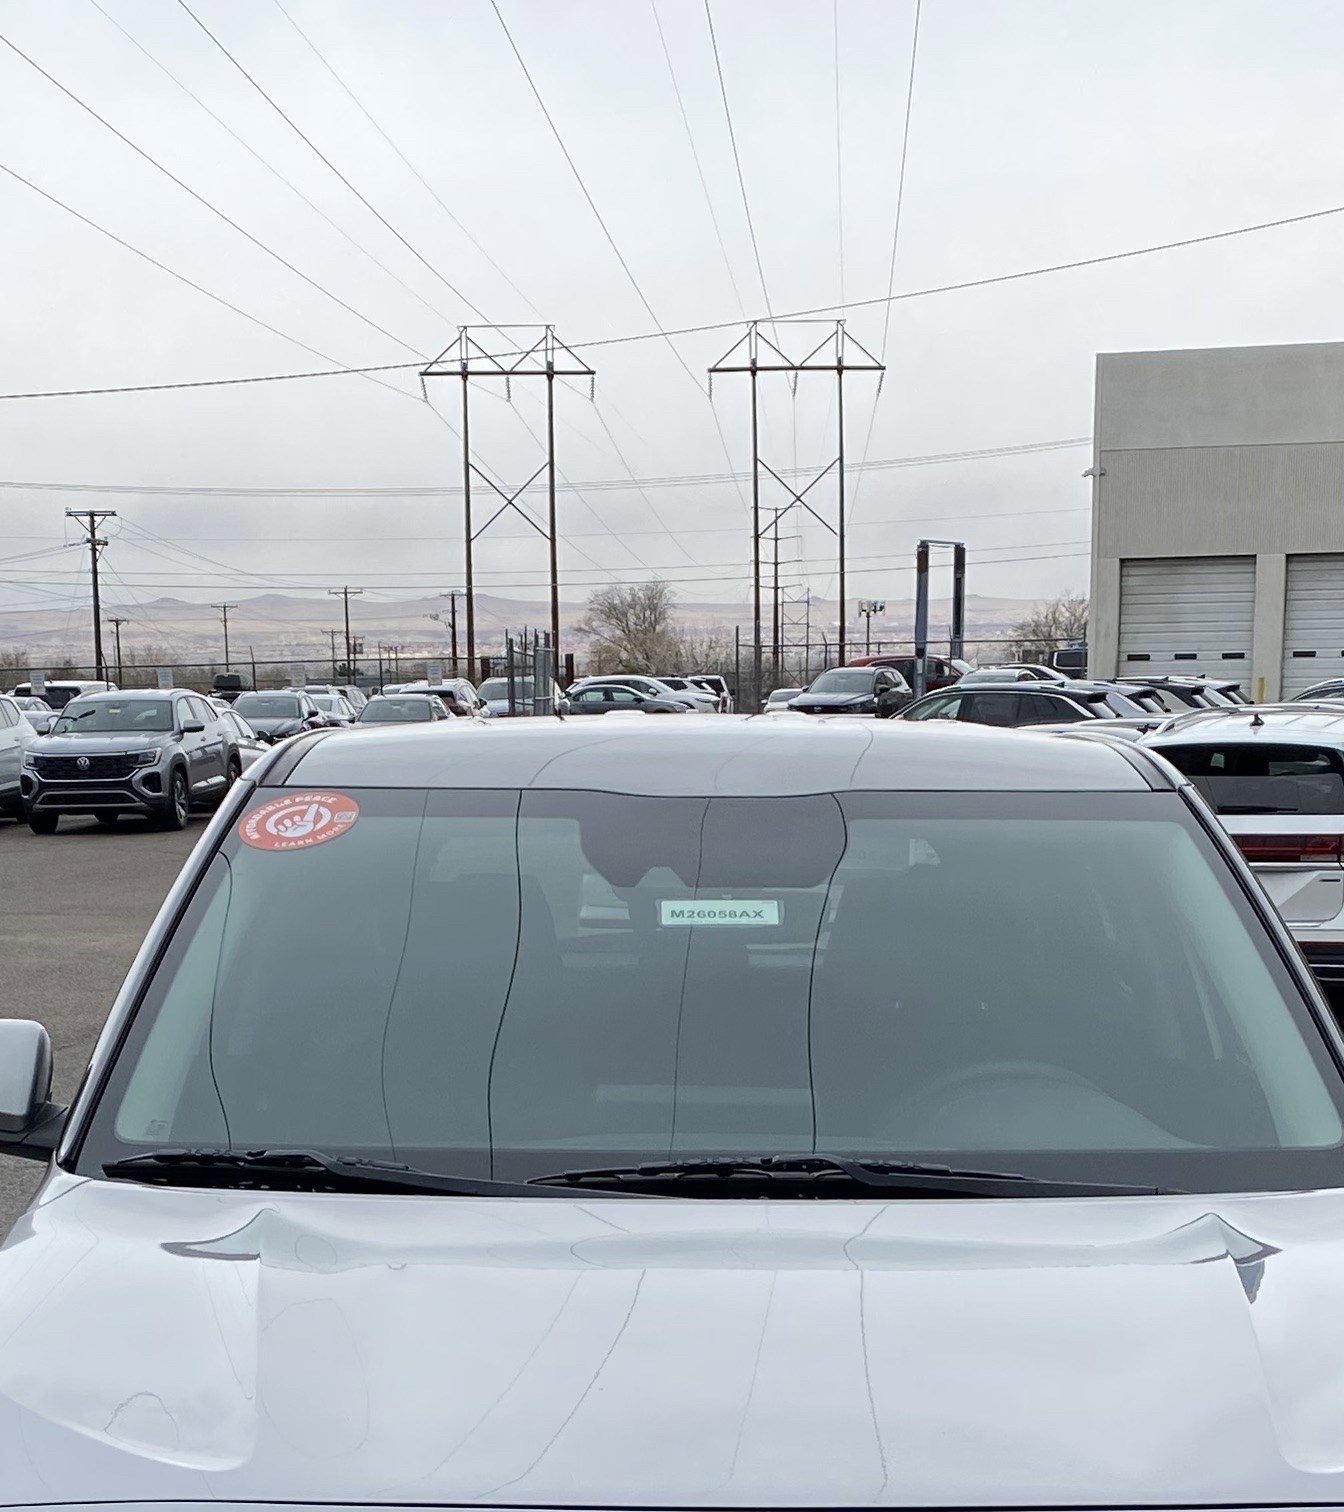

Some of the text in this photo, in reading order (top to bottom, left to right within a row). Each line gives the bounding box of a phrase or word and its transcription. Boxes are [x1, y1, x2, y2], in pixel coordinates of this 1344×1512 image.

[246, 795, 338, 839] AFFORDABLE PEACE
[274, 838, 313, 848] LEARN
[670, 909, 764, 919] M26058AX
